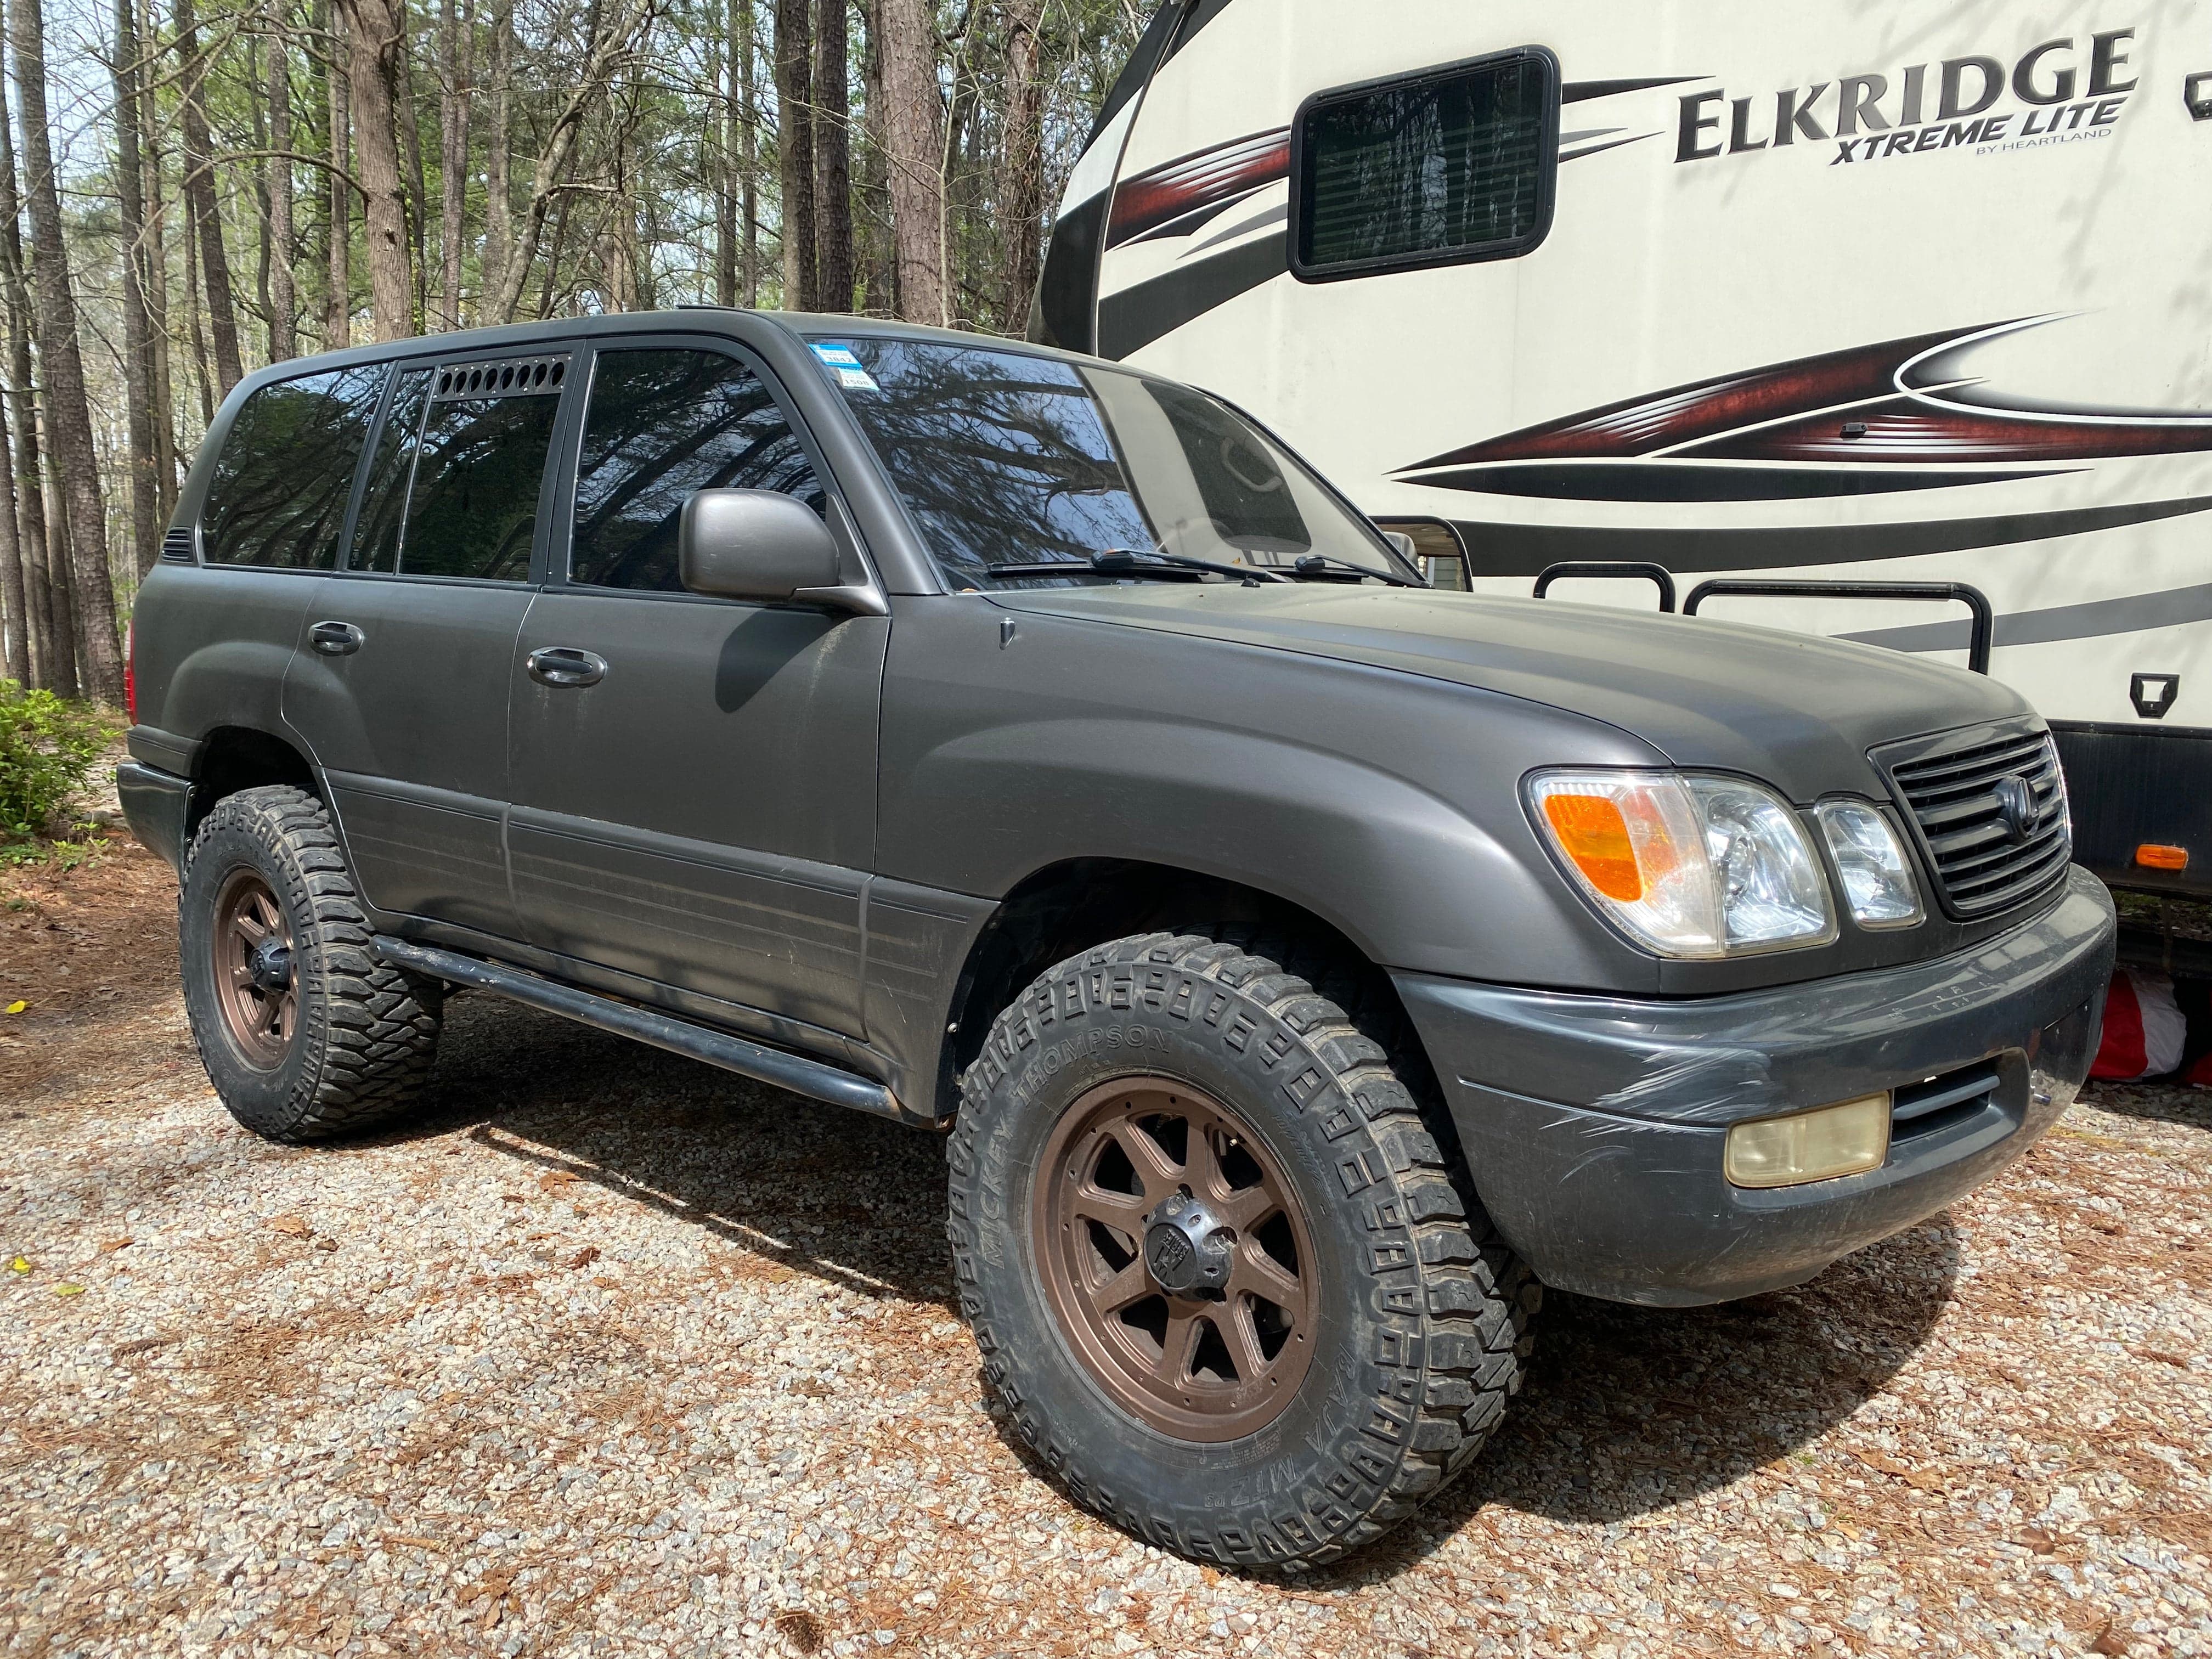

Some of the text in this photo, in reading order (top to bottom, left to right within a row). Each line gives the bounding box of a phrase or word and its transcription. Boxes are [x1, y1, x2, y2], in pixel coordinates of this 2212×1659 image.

[1673, 26, 2139, 164] ELKRIDGE
[1829, 97, 2129, 166] XTREME LITE
[1976, 128, 2112, 155] BY HEARTLAND
[980, 1024, 1171, 1269] MICKEY THOMPSON
[1304, 1342, 1356, 1456] BAJA
[1230, 1453, 1299, 1506] MTZ
